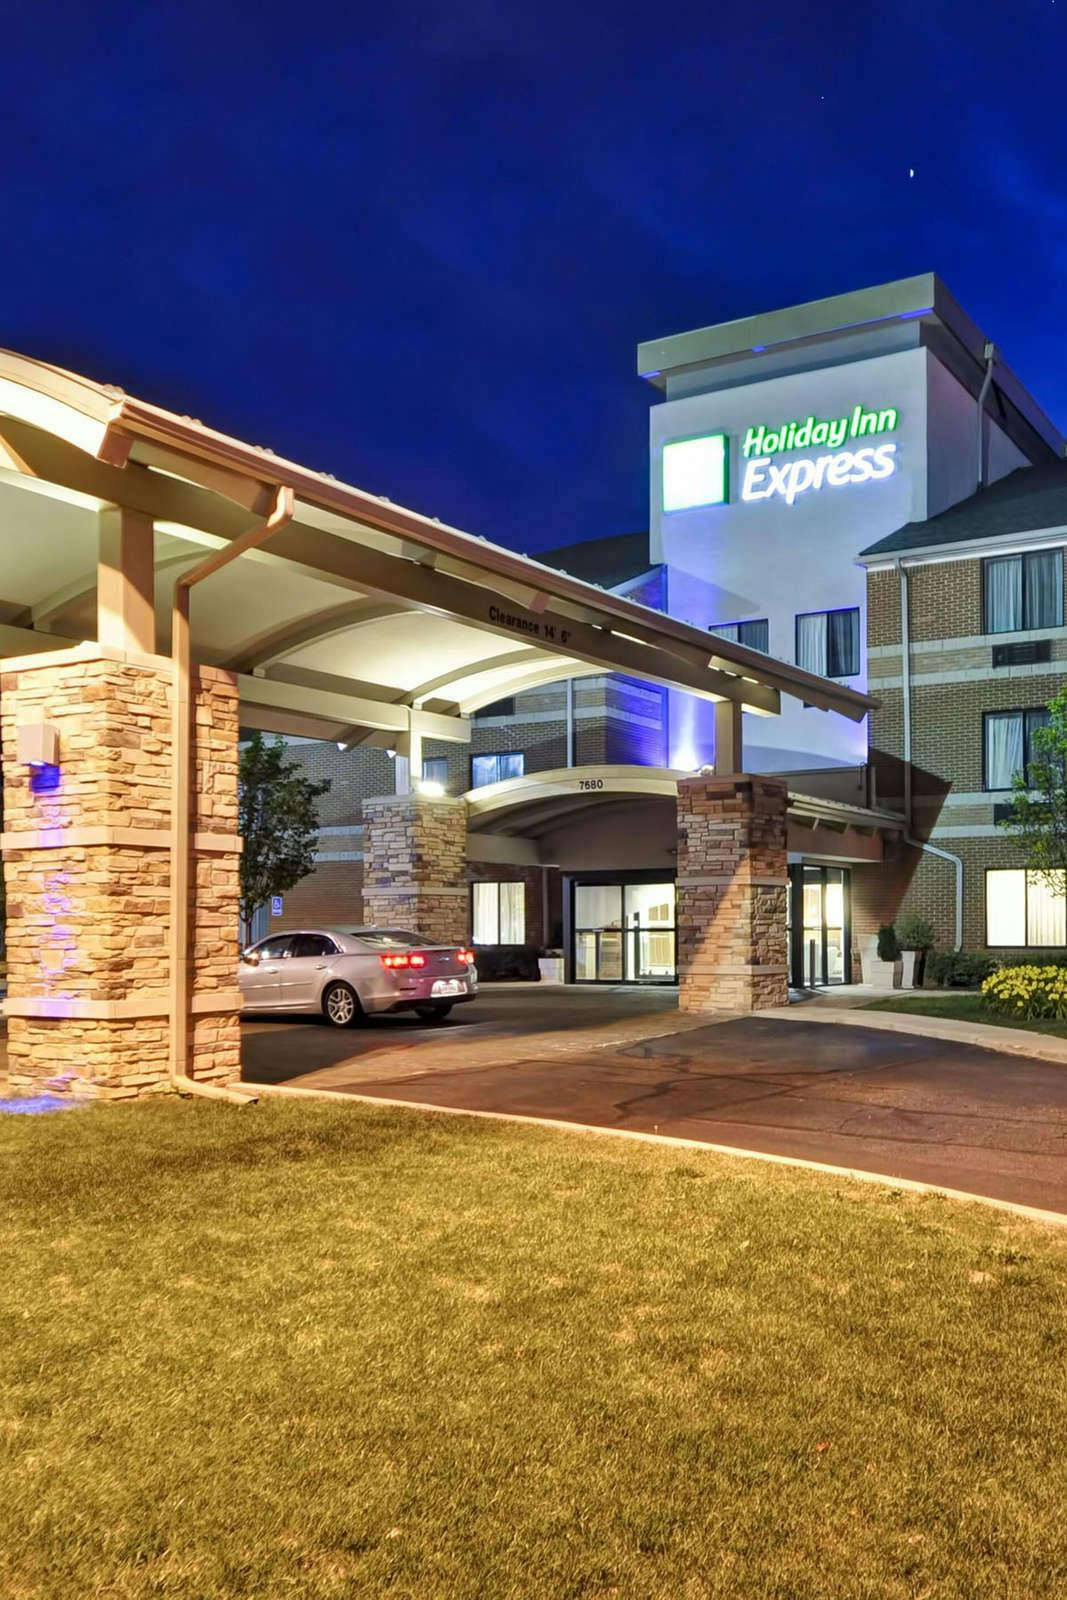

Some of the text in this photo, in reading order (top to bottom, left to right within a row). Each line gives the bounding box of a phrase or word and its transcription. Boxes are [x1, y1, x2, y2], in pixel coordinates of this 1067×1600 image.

[742, 405, 897, 457] Holiday Inn
[741, 444, 897, 504] Express
[489, 606, 539, 634] Clearance
[579, 779, 604, 790] 7680
